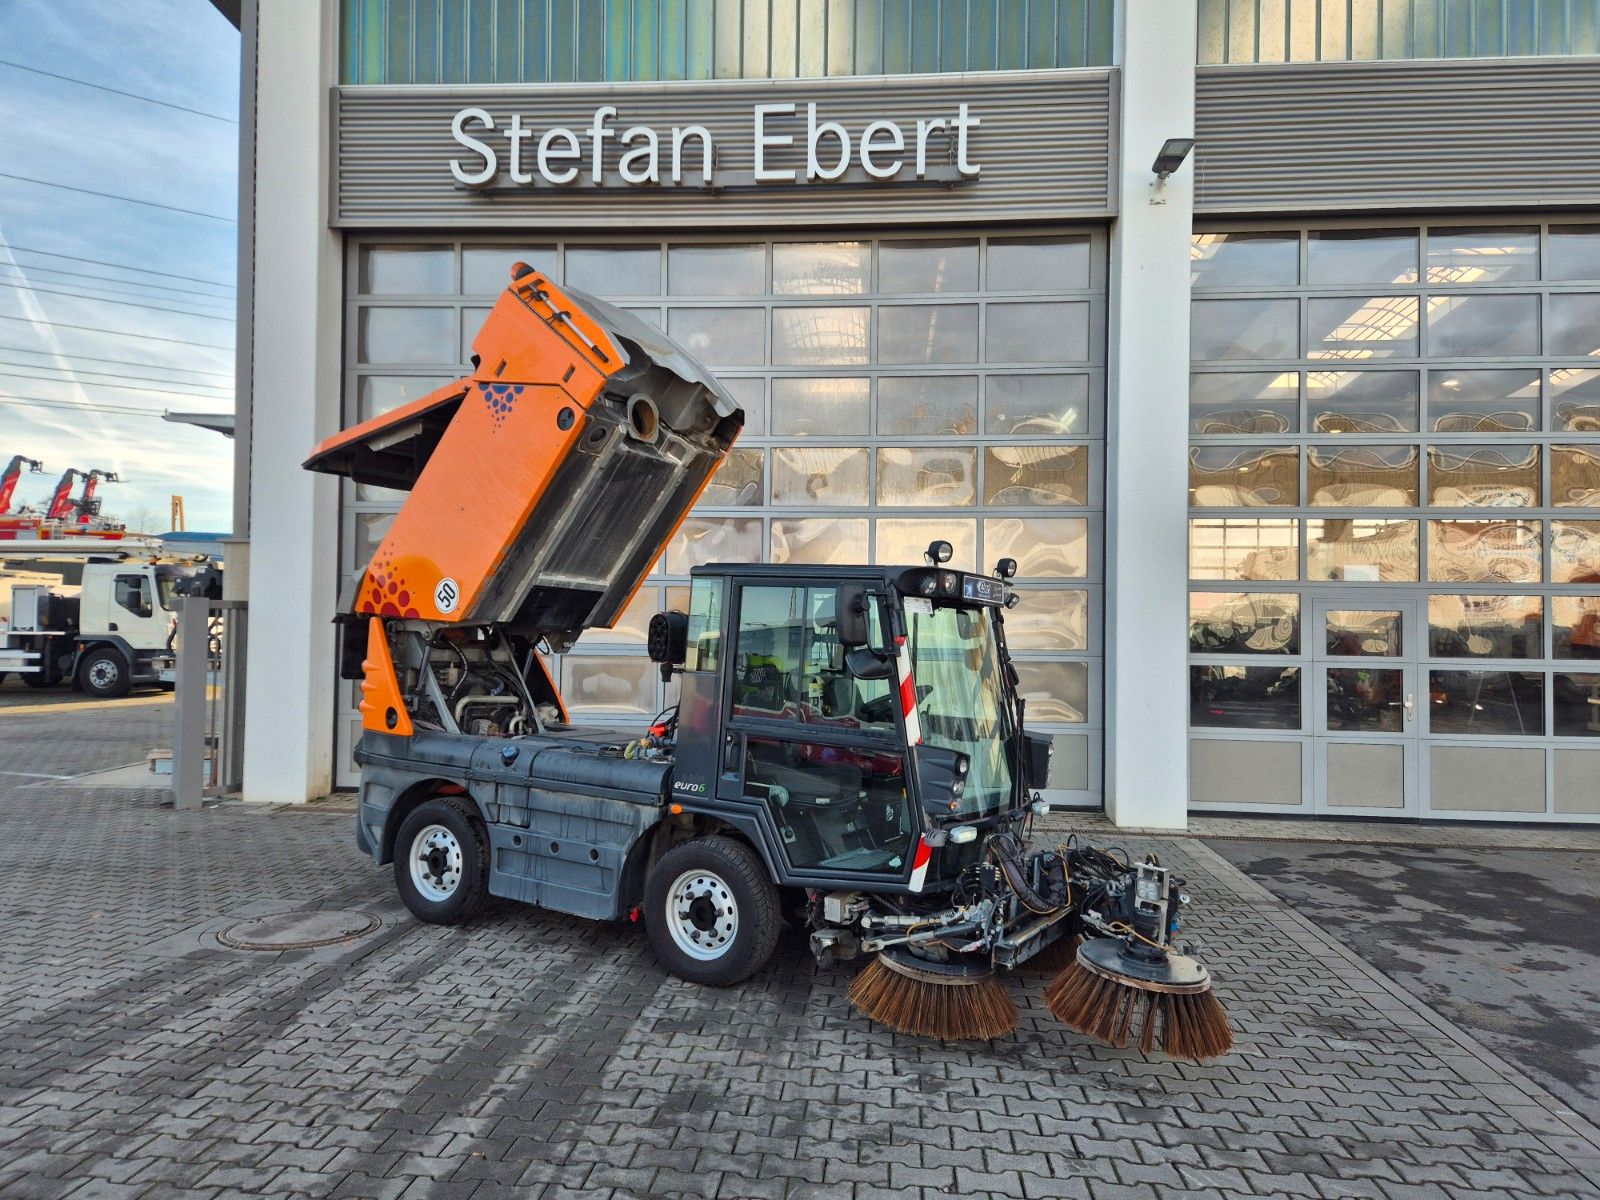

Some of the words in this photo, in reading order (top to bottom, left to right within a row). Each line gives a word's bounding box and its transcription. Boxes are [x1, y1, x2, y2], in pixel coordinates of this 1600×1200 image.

[450, 106, 713, 185] Stefan
[754, 102, 981, 180] Ebert
[437, 582, 456, 608] 50
